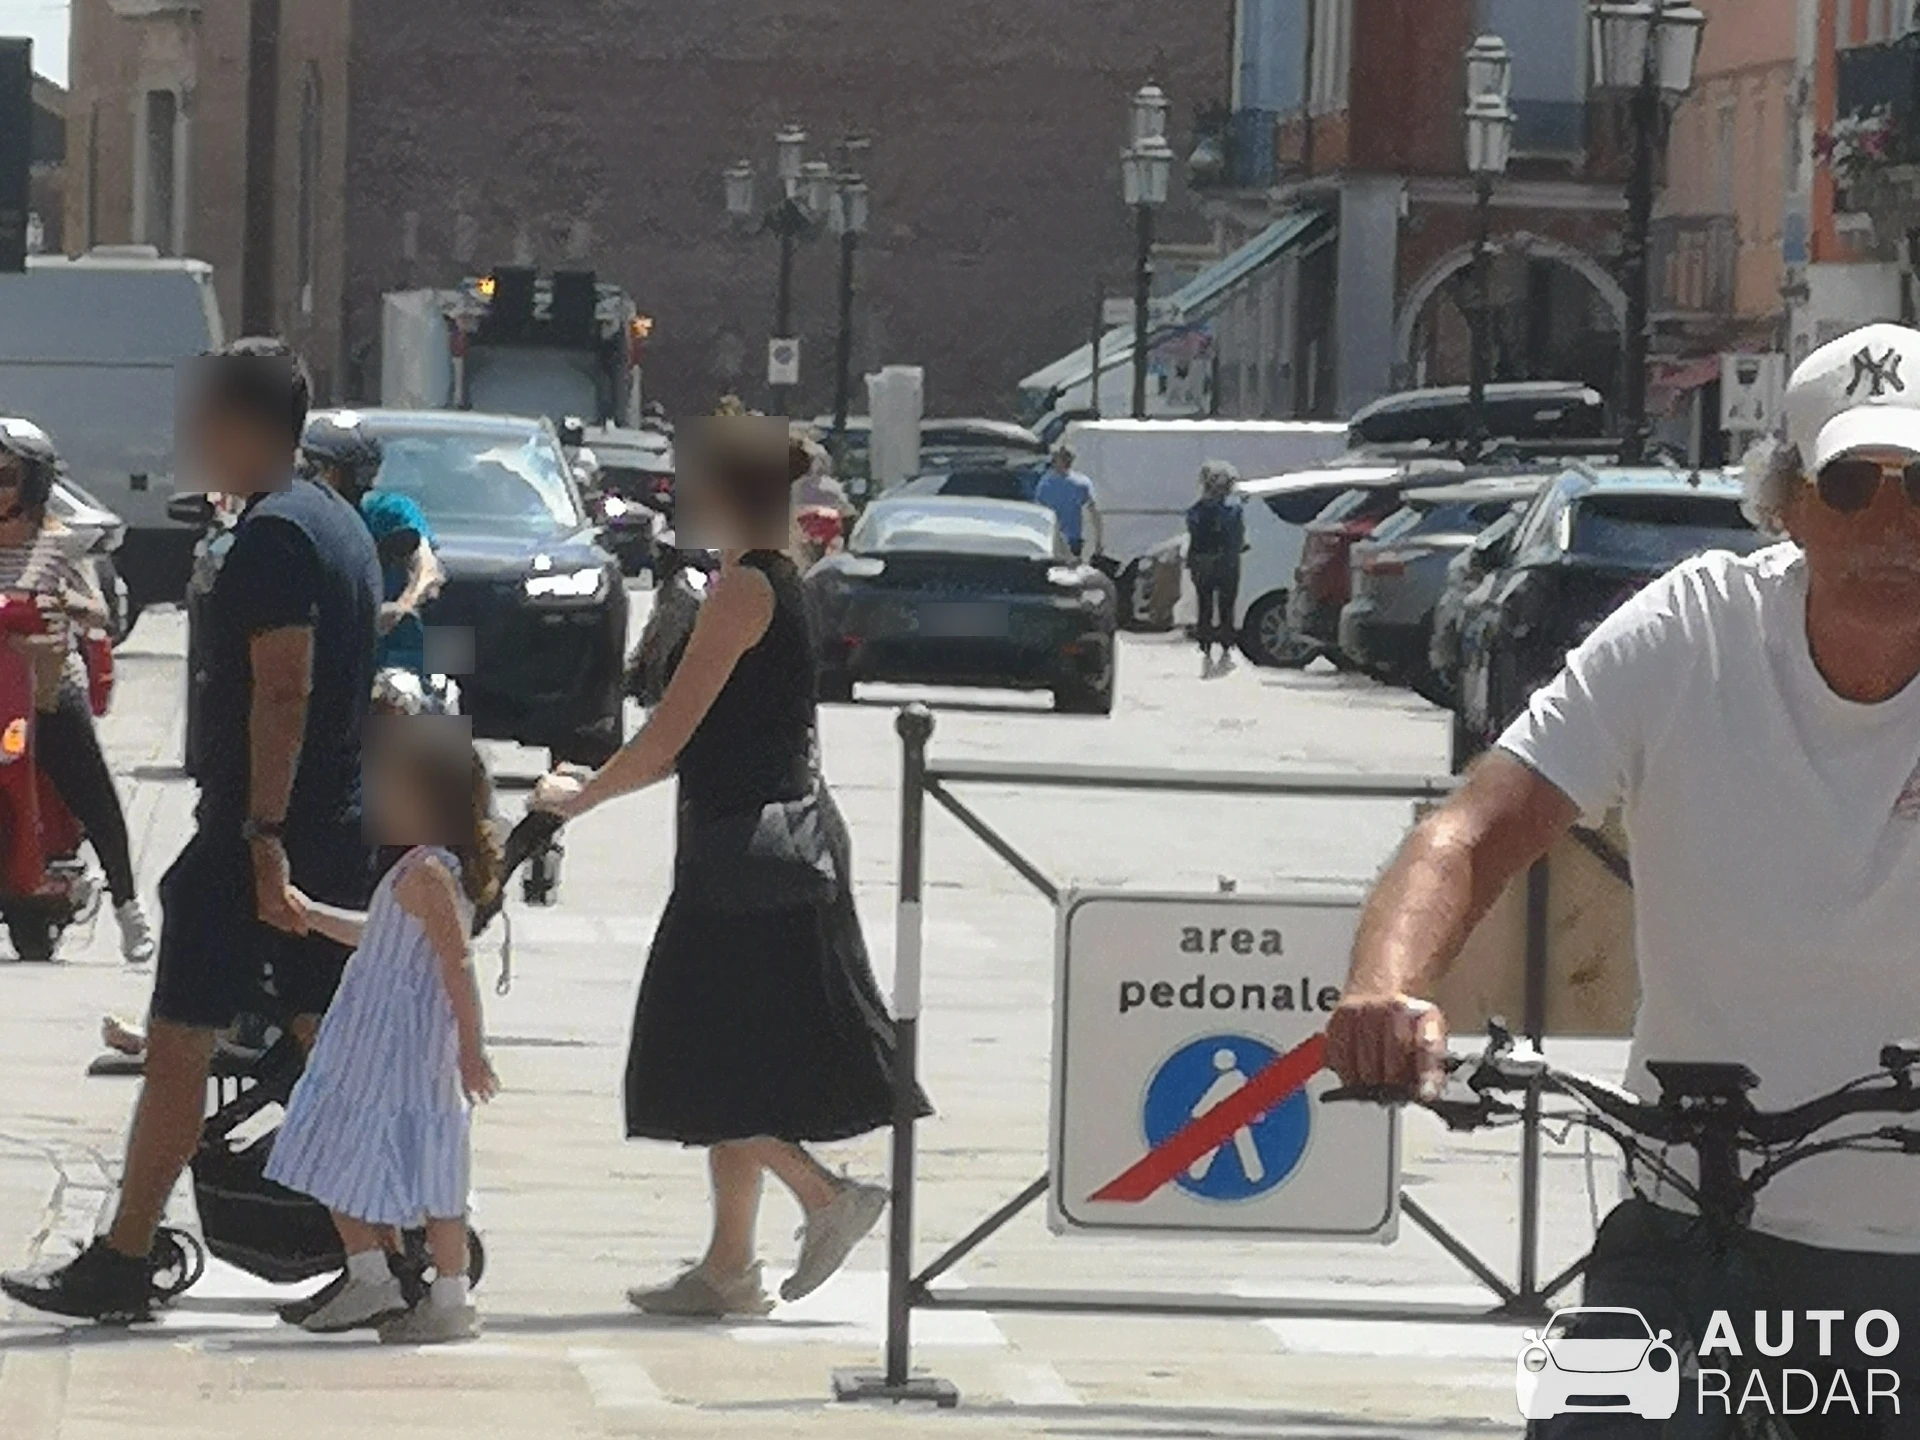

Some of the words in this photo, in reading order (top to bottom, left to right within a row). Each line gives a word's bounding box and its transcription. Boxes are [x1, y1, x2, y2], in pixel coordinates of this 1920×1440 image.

[1846, 346, 1904, 396] NY
[1180, 926, 1284, 956] area
[1119, 974, 1341, 1014] pedonale
